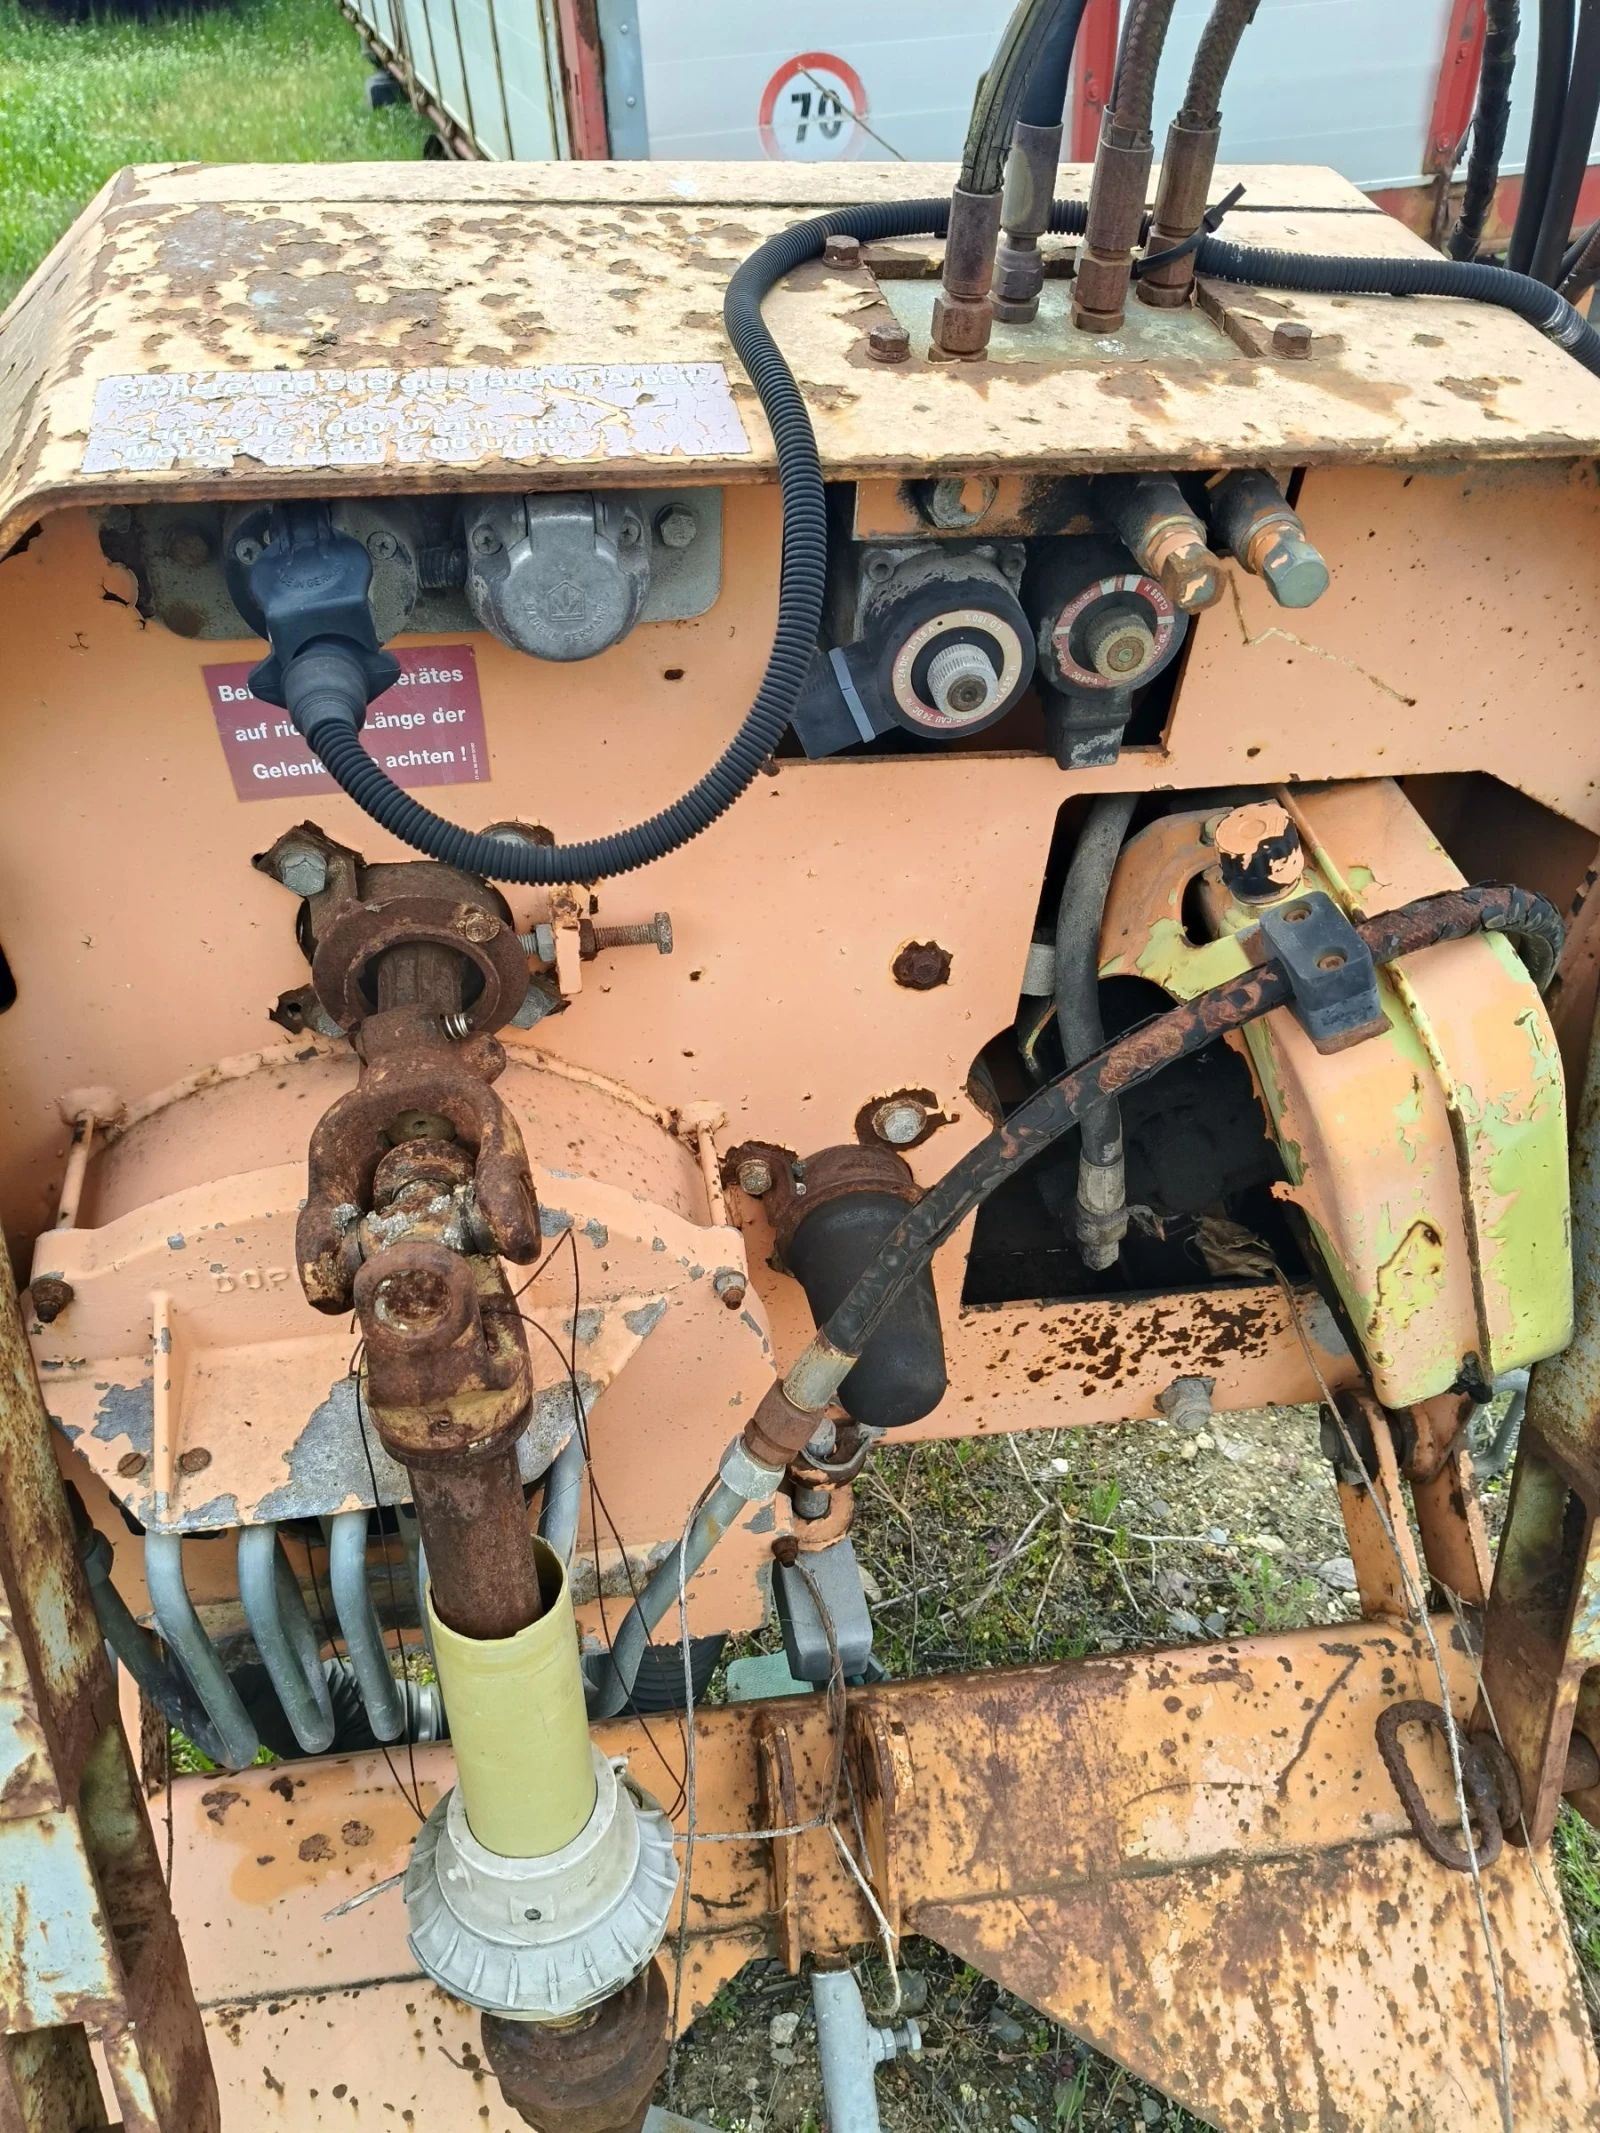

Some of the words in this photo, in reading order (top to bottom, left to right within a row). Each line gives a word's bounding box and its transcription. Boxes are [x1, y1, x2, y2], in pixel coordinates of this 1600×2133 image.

[791, 89, 841, 143] 70
[254, 376, 315, 394] und
[1149, 588, 1168, 611] CLASS
[392, 666, 464, 688] erätes
[235, 722, 267, 742] auf
[432, 706, 466, 725] der
[386, 749, 455, 768] achten
